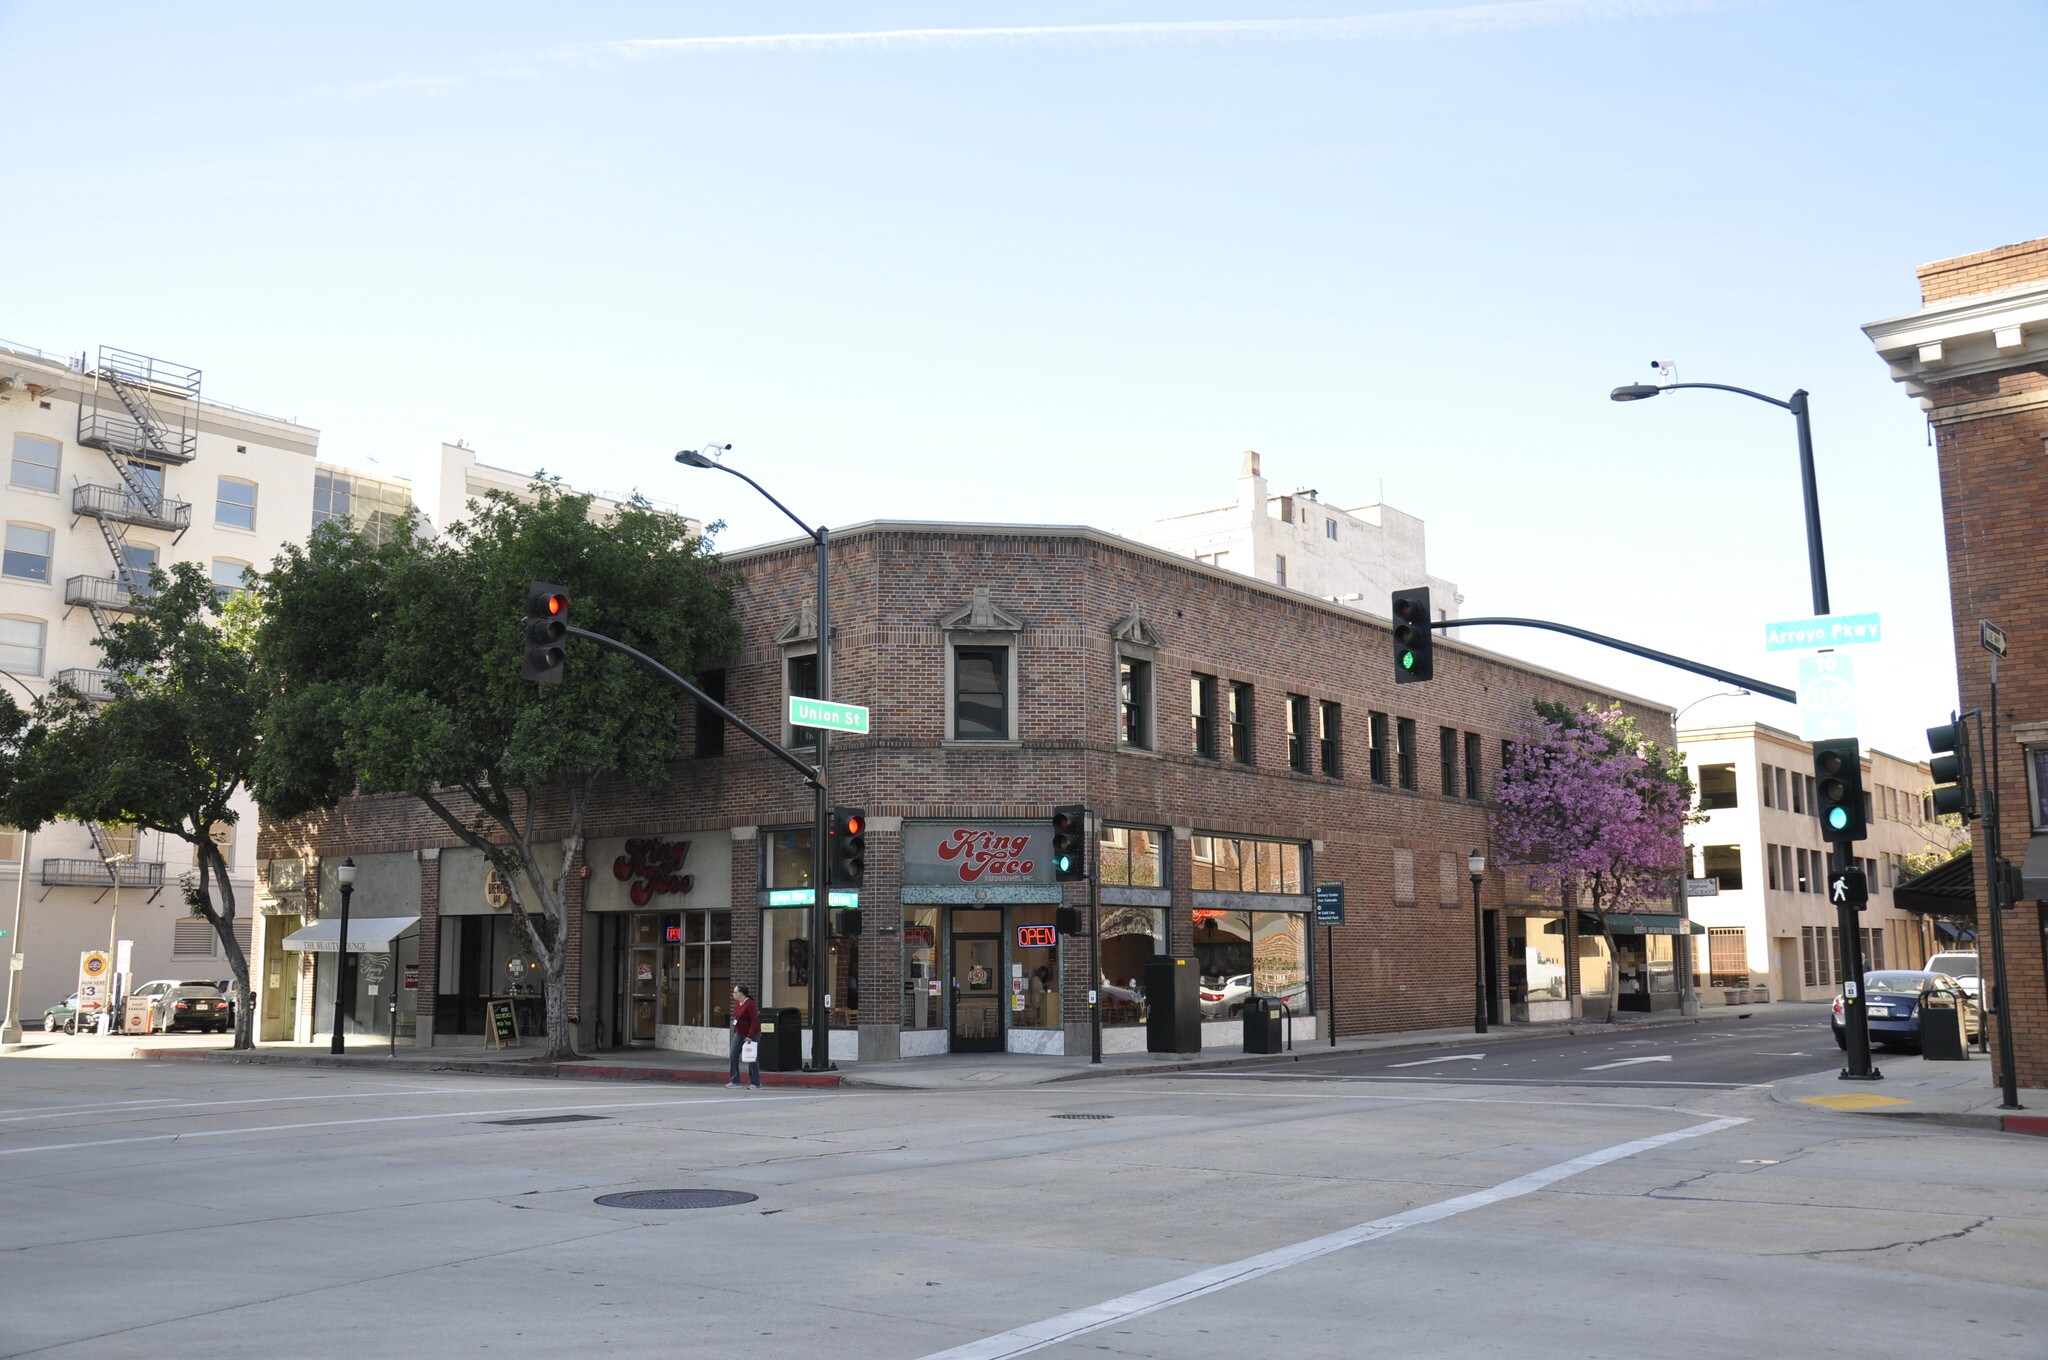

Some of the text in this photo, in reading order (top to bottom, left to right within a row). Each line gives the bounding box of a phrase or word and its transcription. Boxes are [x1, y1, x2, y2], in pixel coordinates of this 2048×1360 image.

[1768, 623, 1880, 644] Arroyo Pkwy
[1815, 656, 1837, 672] TO
[1812, 686, 1845, 705] 110
[799, 704, 860, 725] Union St
[937, 828, 1031, 861] King
[958, 851, 1035, 882] Taco
[303, 941, 316, 950] THE
[316, 941, 340, 951] BEAUTY
[1019, 927, 1056, 946] OPEN
[81, 986, 96, 996] $3
